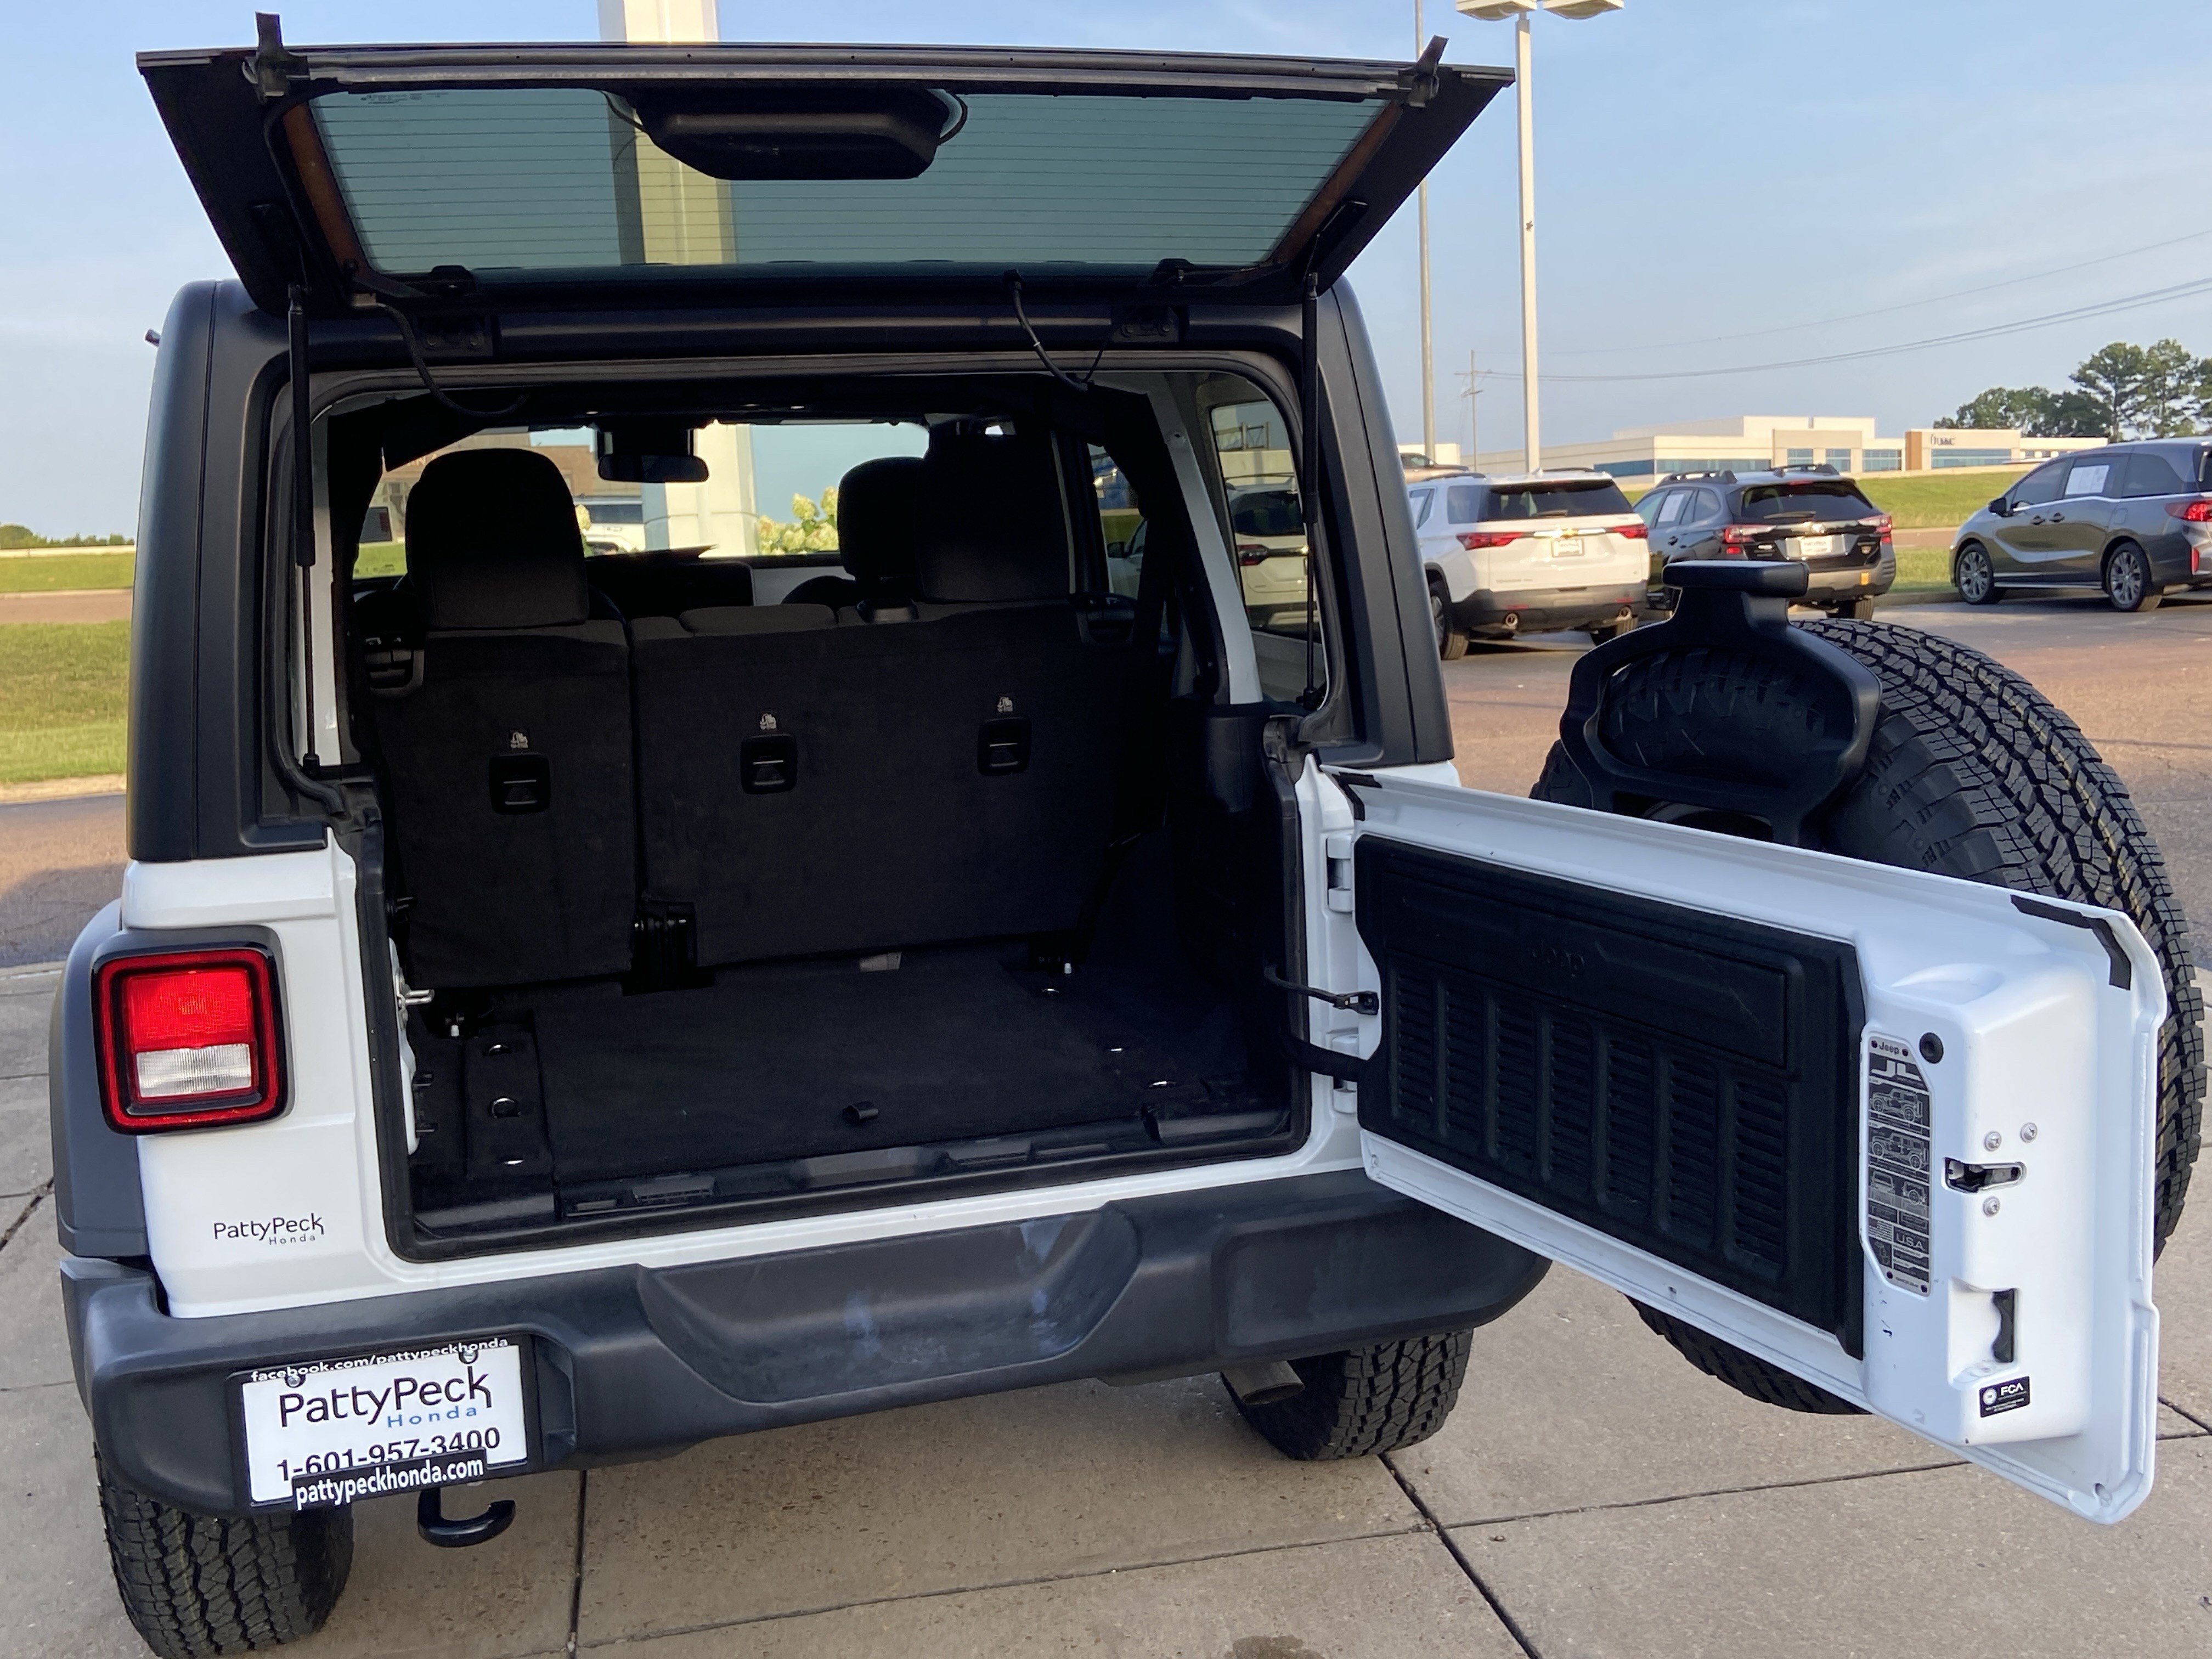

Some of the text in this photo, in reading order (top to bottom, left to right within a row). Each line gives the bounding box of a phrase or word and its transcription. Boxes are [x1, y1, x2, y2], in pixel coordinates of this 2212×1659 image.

[1878, 1042, 1899, 1054] Jeep
[1871, 1059, 1921, 1081] JL
[213, 1212, 324, 1241] PattyPeck
[269, 1234, 315, 1245] Honda
[250, 1338, 508, 1382] facebook.com/pattypeckhonda
[279, 1365, 492, 1427] PattyPeck
[2000, 1383, 2024, 1396] FCA
[387, 1406, 477, 1428] Honda
[276, 1427, 500, 1481] 1-601-957-3400
[295, 1458, 484, 1511] pattypeckhonda.com
